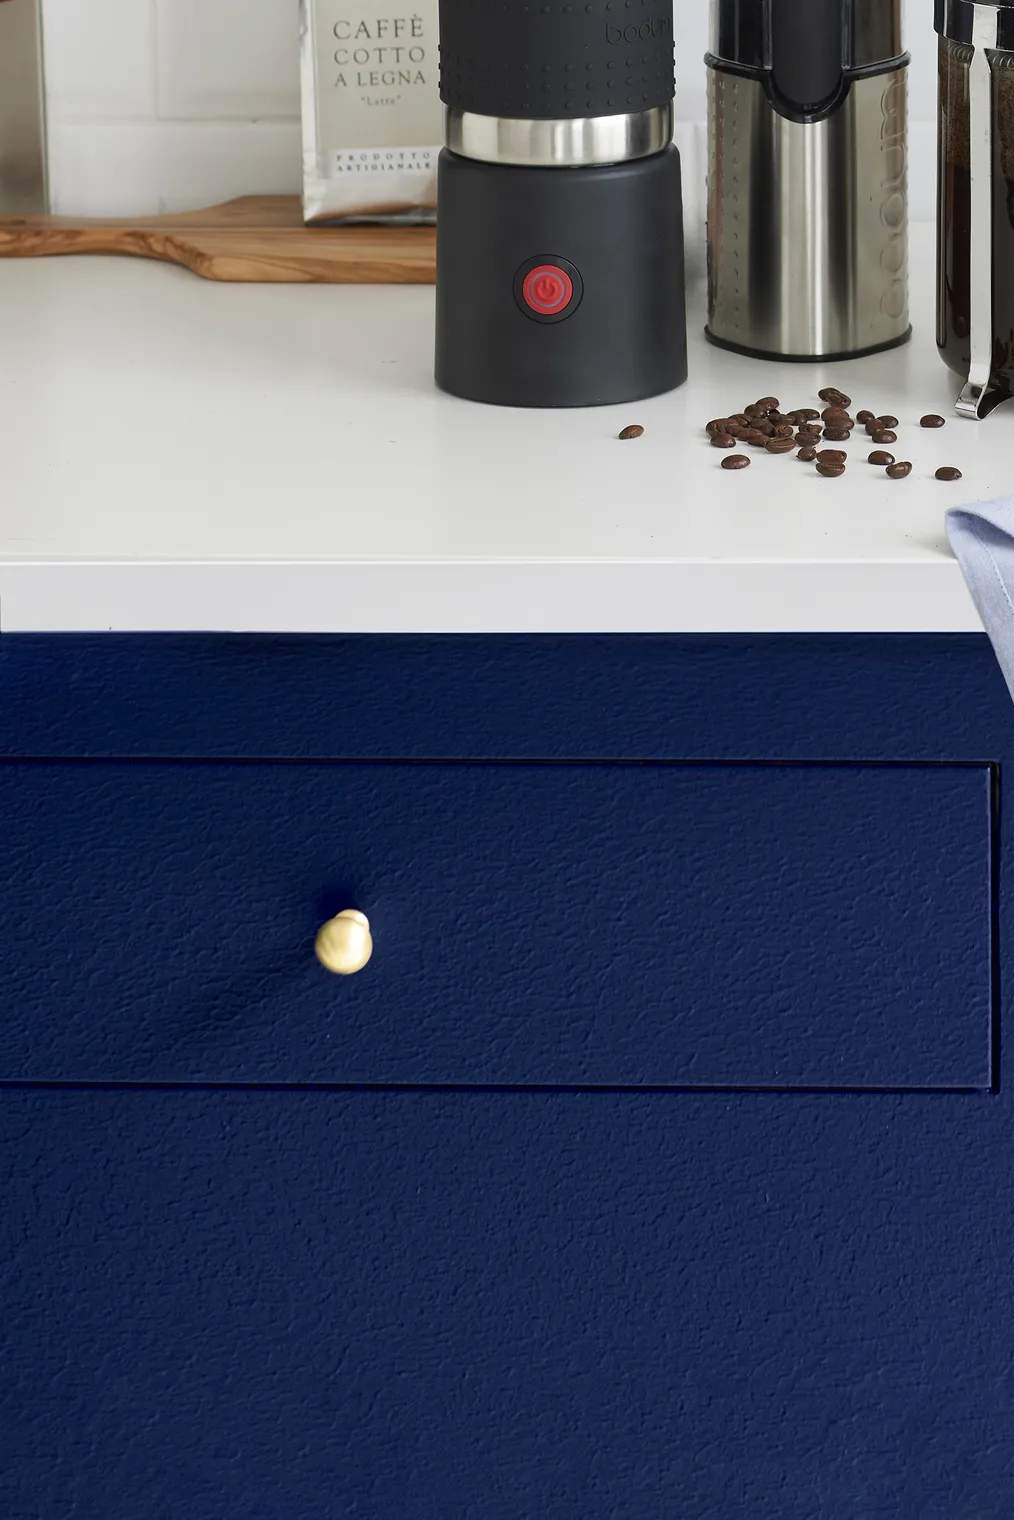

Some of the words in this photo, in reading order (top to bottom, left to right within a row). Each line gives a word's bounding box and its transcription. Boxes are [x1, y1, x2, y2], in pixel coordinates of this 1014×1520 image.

[333, 13, 424, 40] CAFFÈ
[334, 46, 425, 65] COTTO
[334, 72, 347, 87] A
[357, 69, 426, 87] LEGNA
